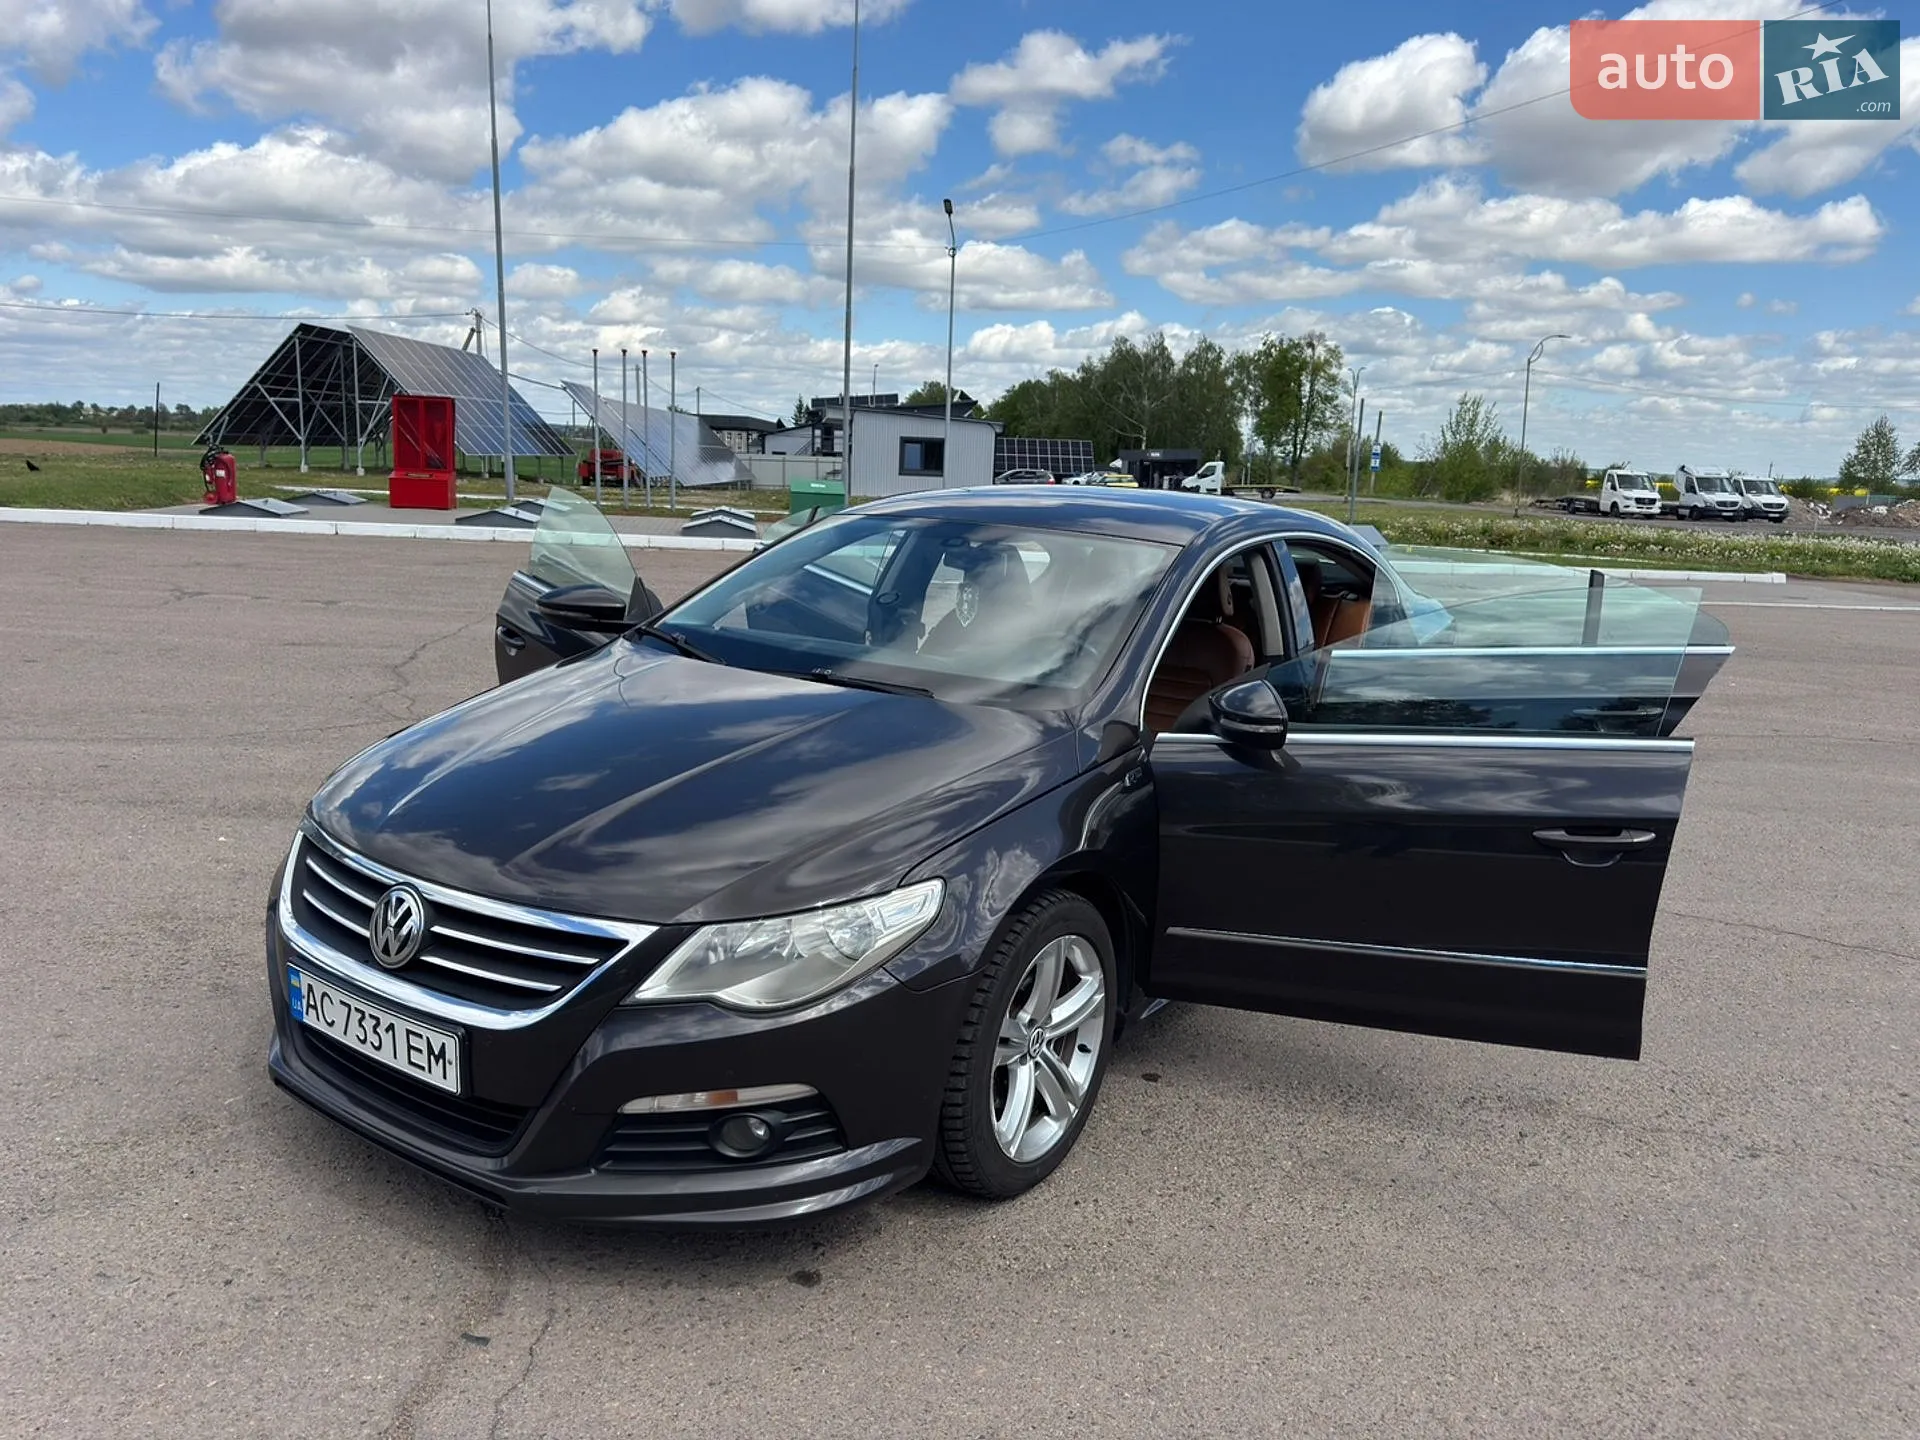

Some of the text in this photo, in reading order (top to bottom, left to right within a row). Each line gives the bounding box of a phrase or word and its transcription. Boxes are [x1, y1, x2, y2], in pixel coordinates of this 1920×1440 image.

[305, 982, 447, 1081] AC 7331 EM
